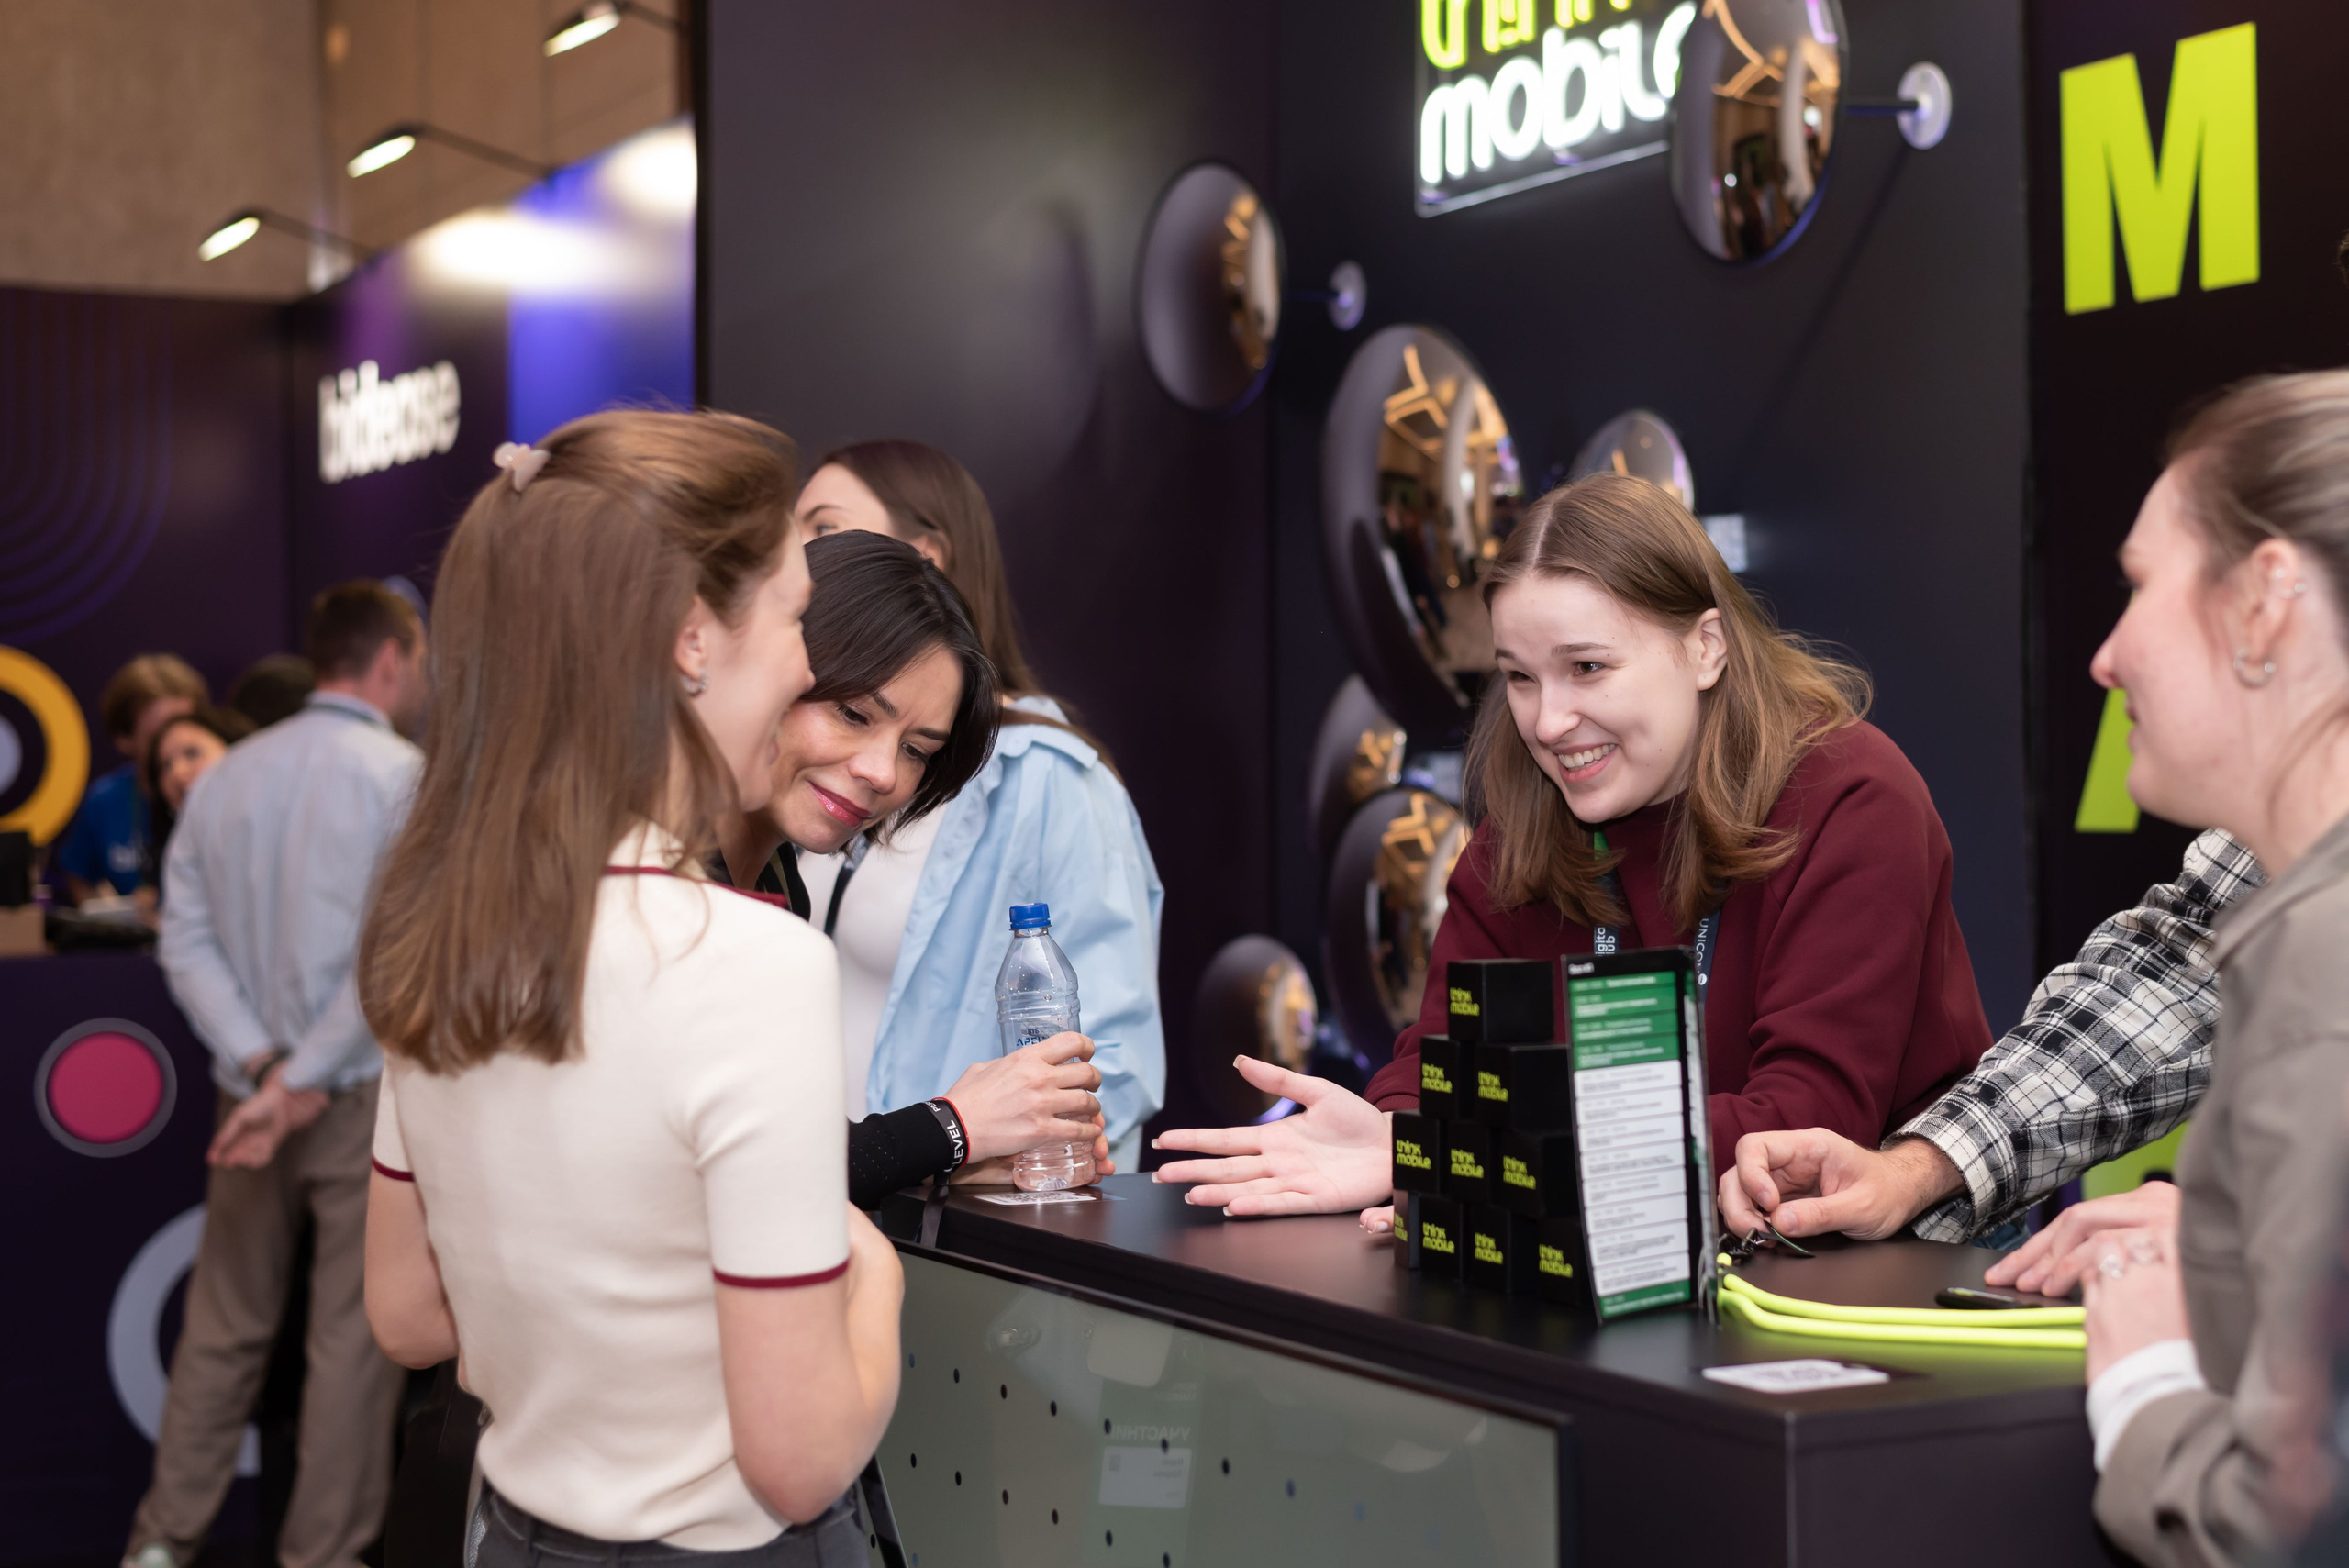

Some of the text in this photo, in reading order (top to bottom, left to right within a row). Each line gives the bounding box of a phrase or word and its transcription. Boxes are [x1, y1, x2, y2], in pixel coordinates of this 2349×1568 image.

[2059, 21, 2260, 315] M
[1016, 1036, 1051, 1047] АРЕН
[946, 1119, 963, 1165] LEVEL
[1397, 1139, 1421, 1155] think
[1397, 1153, 1431, 1170] mobile
[1451, 1149, 1475, 1164] think
[1451, 1162, 1485, 1179] mobile
[1423, 1222, 1446, 1240] think
[1423, 1236, 1455, 1254] mobile
